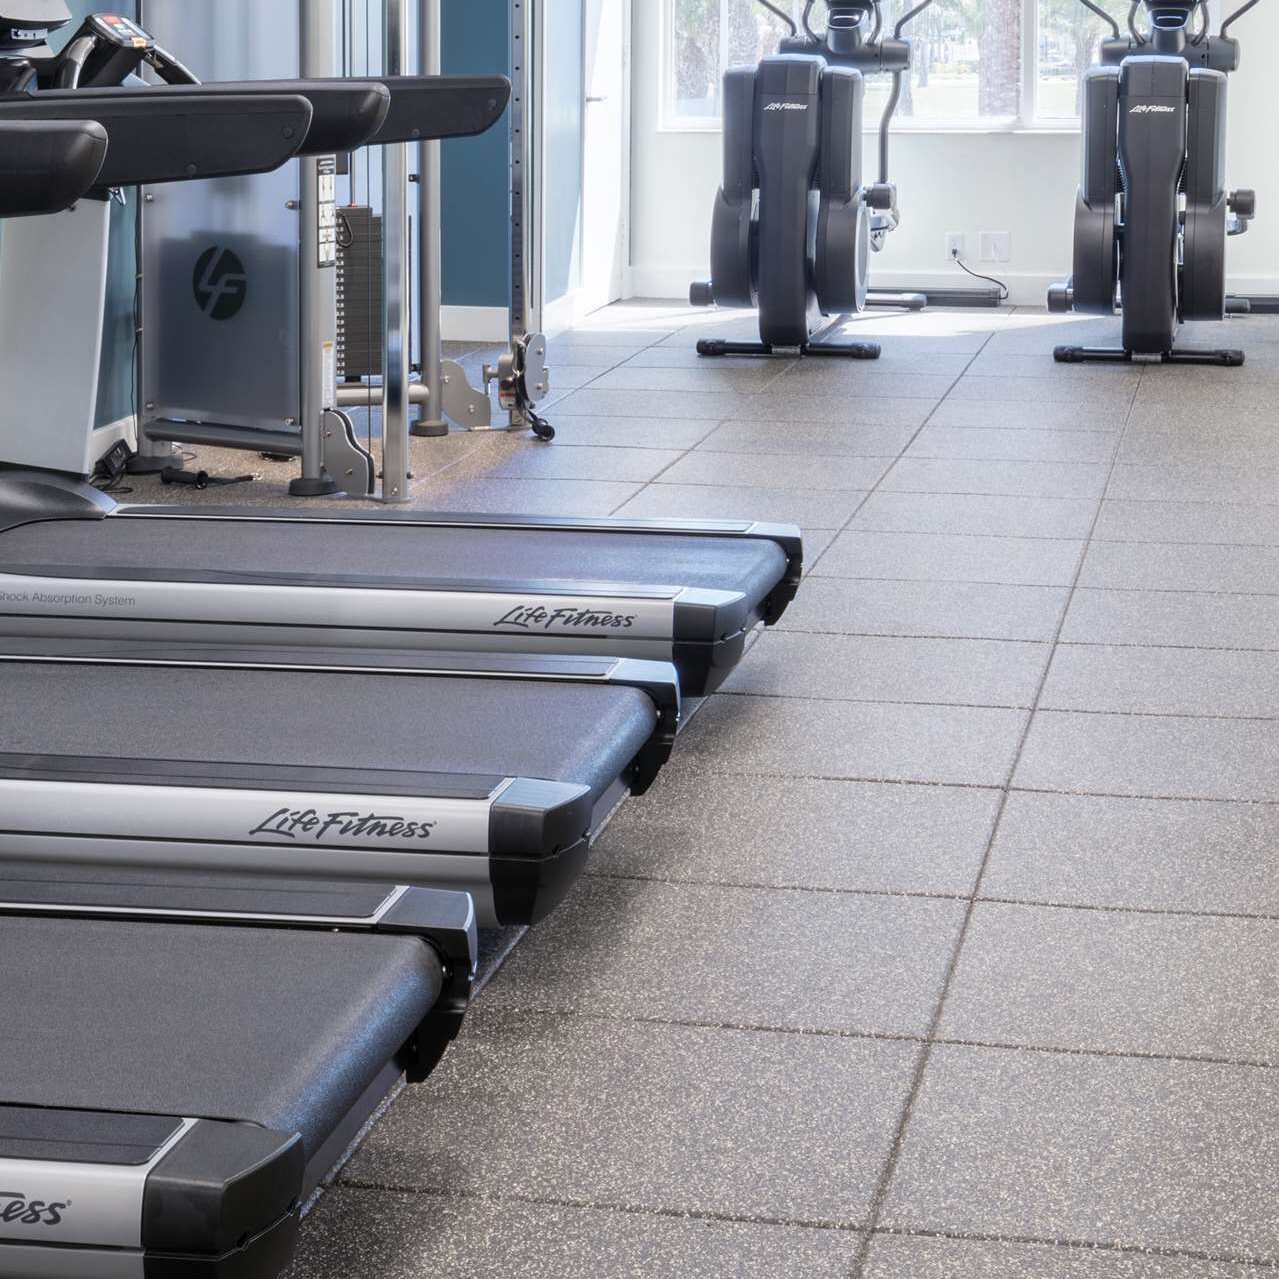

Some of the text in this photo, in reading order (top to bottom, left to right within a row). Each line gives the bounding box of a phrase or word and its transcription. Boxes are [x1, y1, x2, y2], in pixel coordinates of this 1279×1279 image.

[31, 591, 92, 607] Absorption
[94, 593, 136, 609] System
[493, 605, 635, 629] Life Fitness
[249, 807, 433, 840] Life Fitness
